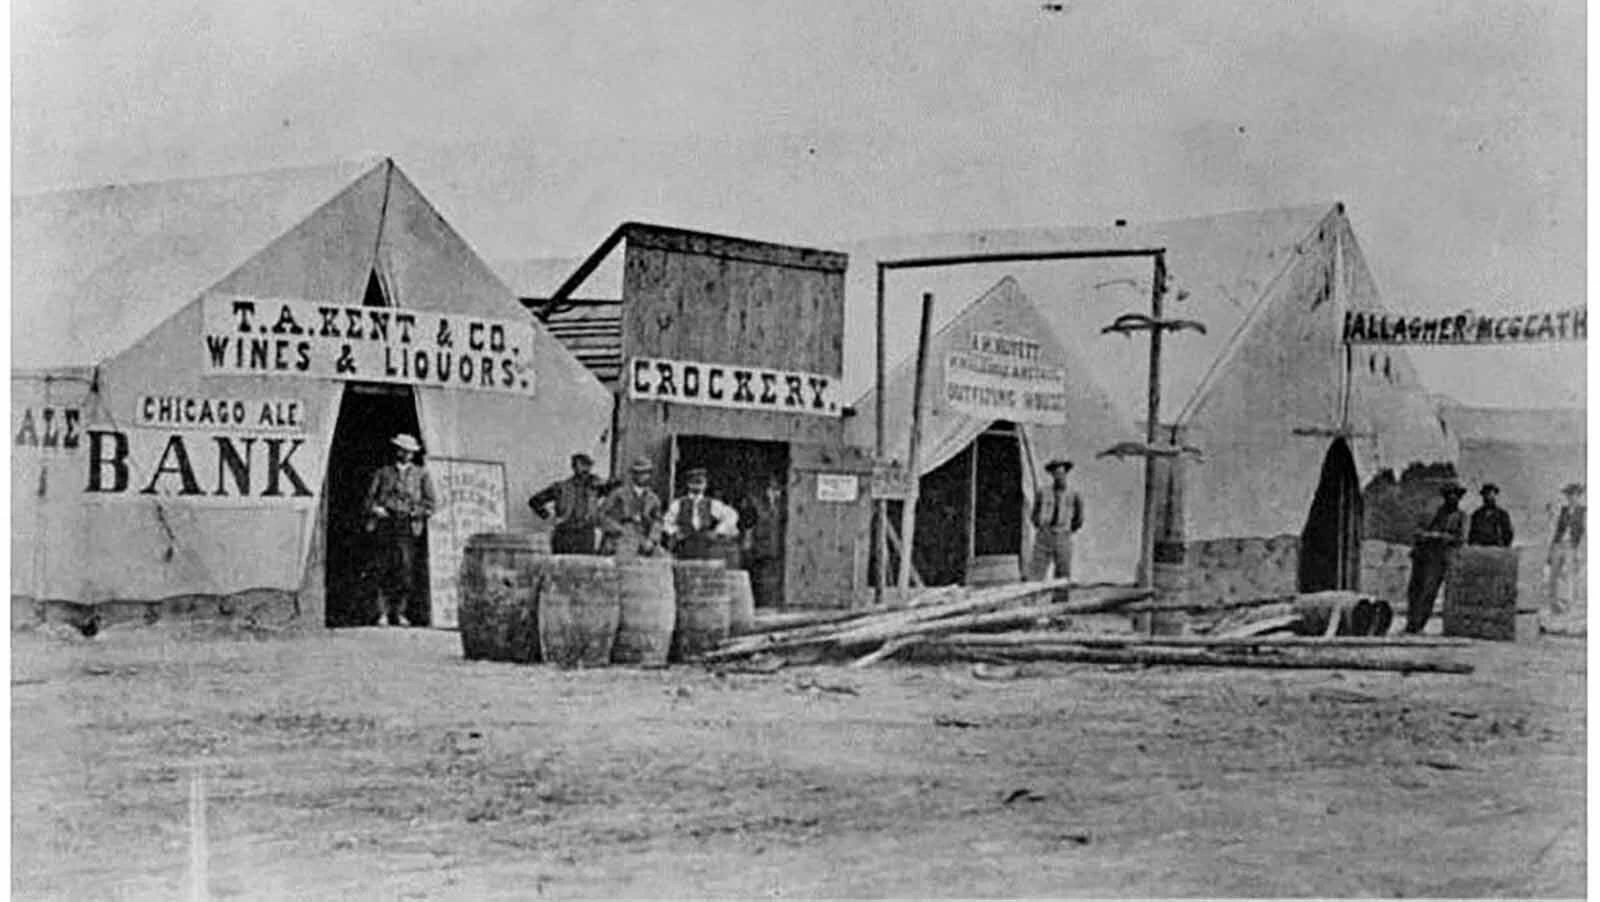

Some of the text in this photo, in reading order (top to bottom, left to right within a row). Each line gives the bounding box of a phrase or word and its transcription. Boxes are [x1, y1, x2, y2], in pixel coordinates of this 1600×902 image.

[436, 318, 453, 348] &
[469, 322, 519, 355] CO.
[206, 335, 528, 388] WINES & LIQUORS.
[634, 360, 836, 411] CROCKERY.
[15, 407, 79, 448] ALE
[143, 397, 246, 424] CHICAGO
[83, 430, 314, 498] BANK
